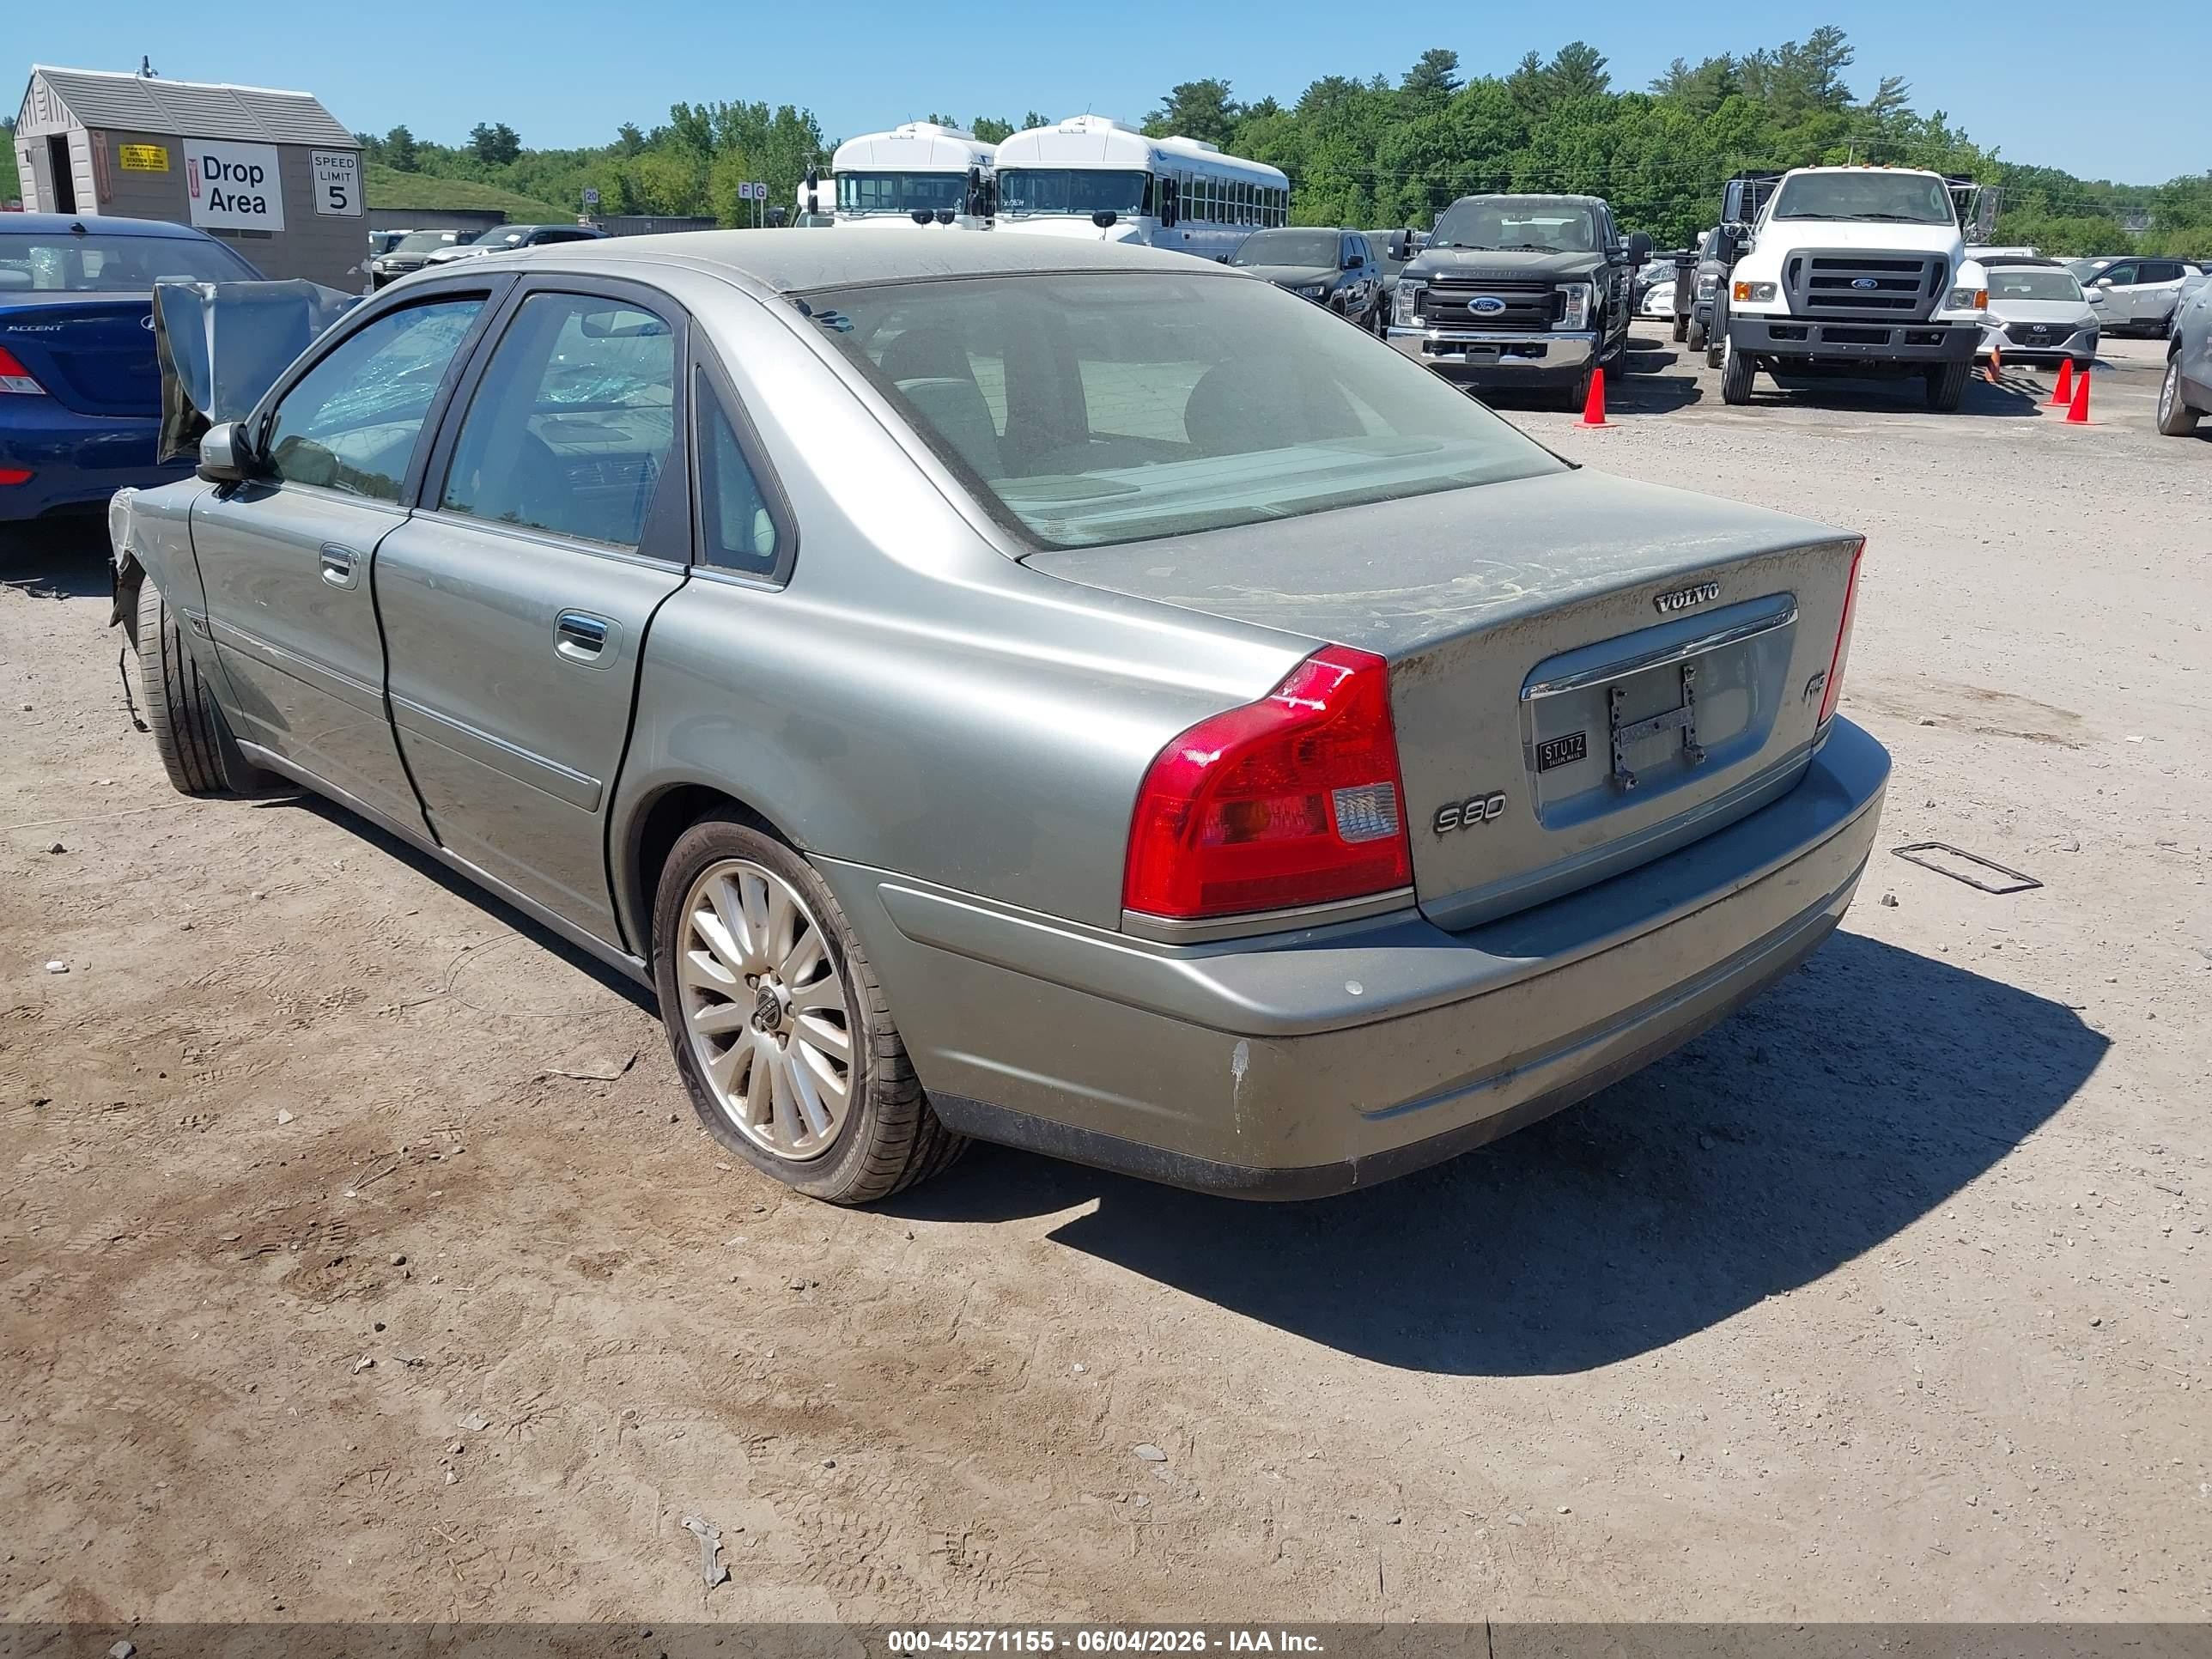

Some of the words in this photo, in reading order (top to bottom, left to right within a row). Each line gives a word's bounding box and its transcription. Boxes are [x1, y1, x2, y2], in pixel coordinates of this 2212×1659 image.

[203, 155, 264, 188] Drop
[315, 156, 355, 168] SPEED
[320, 172, 351, 182] LIMIT
[209, 187, 267, 214] Area
[329, 185, 347, 210] 5
[586, 191, 598, 201] 20
[742, 185, 749, 197] F
[756, 185, 764, 198] G
[1655, 583, 1719, 612] VOLVO
[1545, 736, 1583, 760] STUTZ
[1437, 793, 1506, 833] S80
